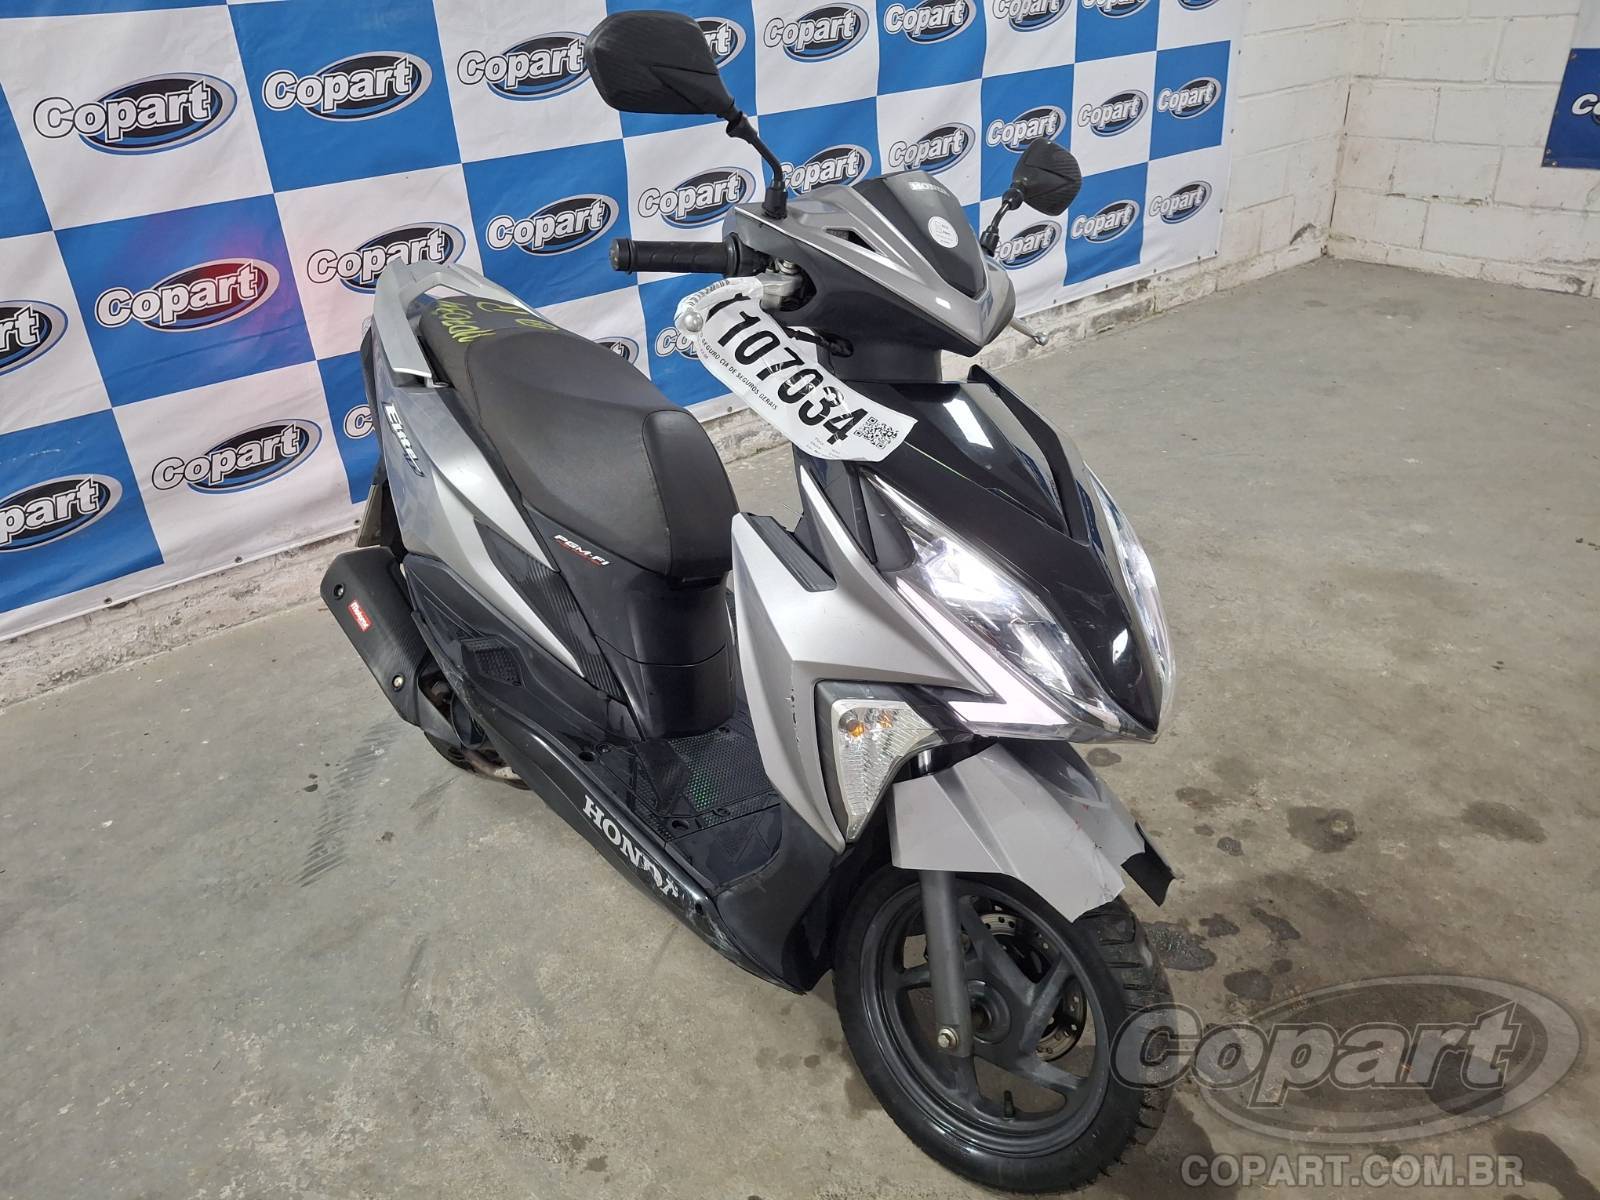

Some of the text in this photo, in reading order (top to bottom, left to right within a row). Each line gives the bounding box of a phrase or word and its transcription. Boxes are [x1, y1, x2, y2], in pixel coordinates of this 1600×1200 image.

[763, 9, 857, 52] Copart
[884, 0, 966, 38] Copart
[263, 58, 413, 112] Copart
[457, 39, 587, 90] Copart
[33, 80, 212, 142] Copart
[1077, 95, 1140, 128] Copart
[1157, 81, 1216, 113] Copart
[889, 128, 967, 171] Copart
[986, 110, 1059, 147] Copart
[638, 170, 742, 221] Copart
[1149, 185, 1204, 217] Copart
[486, 199, 607, 250] Copart
[994, 224, 1054, 263] opart
[1071, 205, 1133, 240] Copart
[95, 260, 259, 328] Copart
[702, 339, 720, 360] SEGURO
[736, 372, 759, 395] SEGUROS
[759, 393, 777, 410] GERAIS
[706, 293, 868, 444] 1107034
[152, 424, 302, 490] Copart
[0, 476, 101, 546] part
